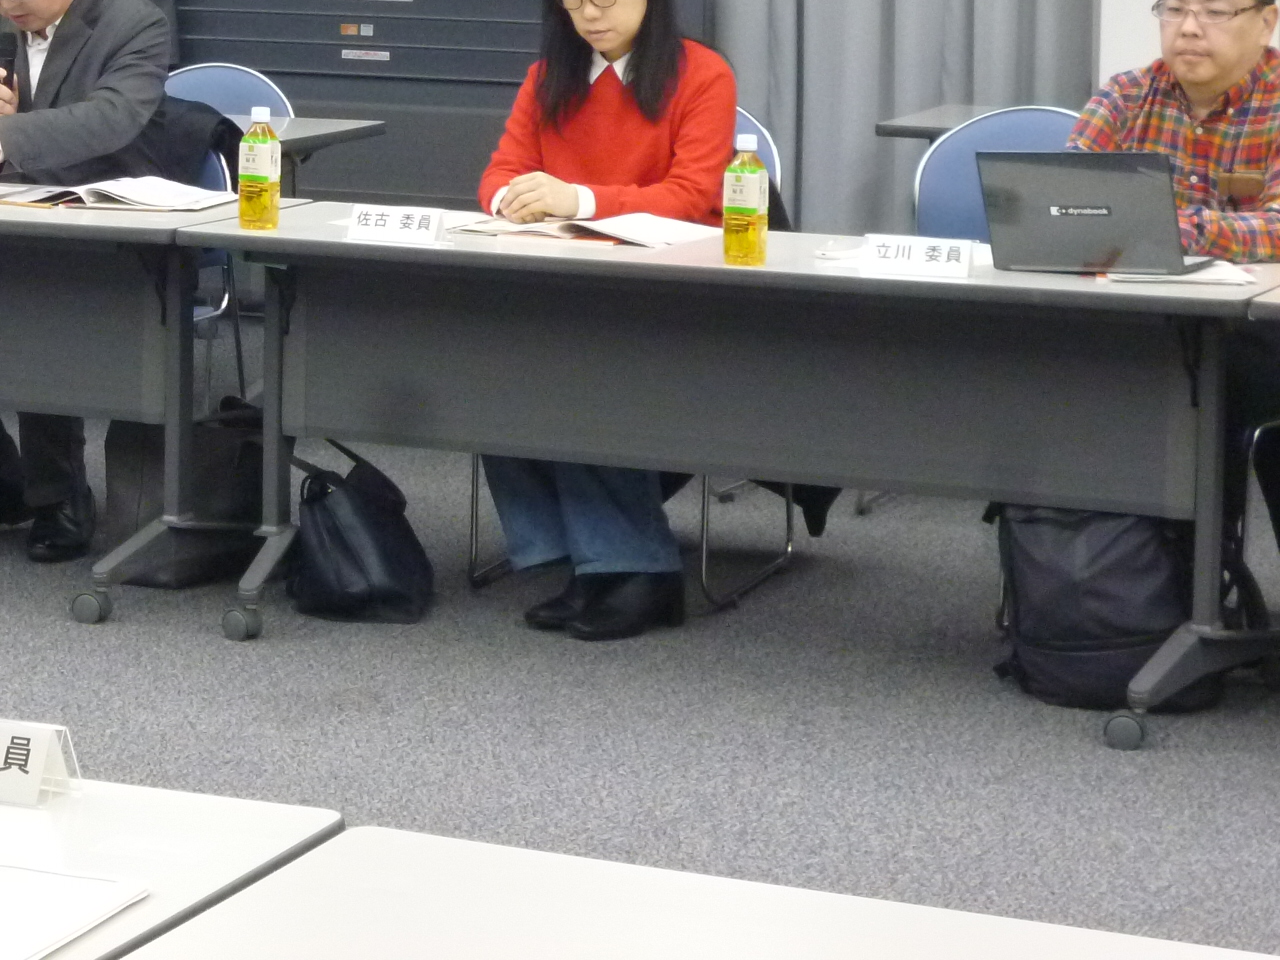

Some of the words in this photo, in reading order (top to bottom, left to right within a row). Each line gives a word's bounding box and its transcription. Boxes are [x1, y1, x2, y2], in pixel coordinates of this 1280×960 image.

[357, 211, 390, 227] 佐古
[399, 213, 431, 231] 委員
[1067, 207, 1109, 216] dynabook
[876, 242, 912, 260] 立川
[925, 245, 962, 263] 委員
